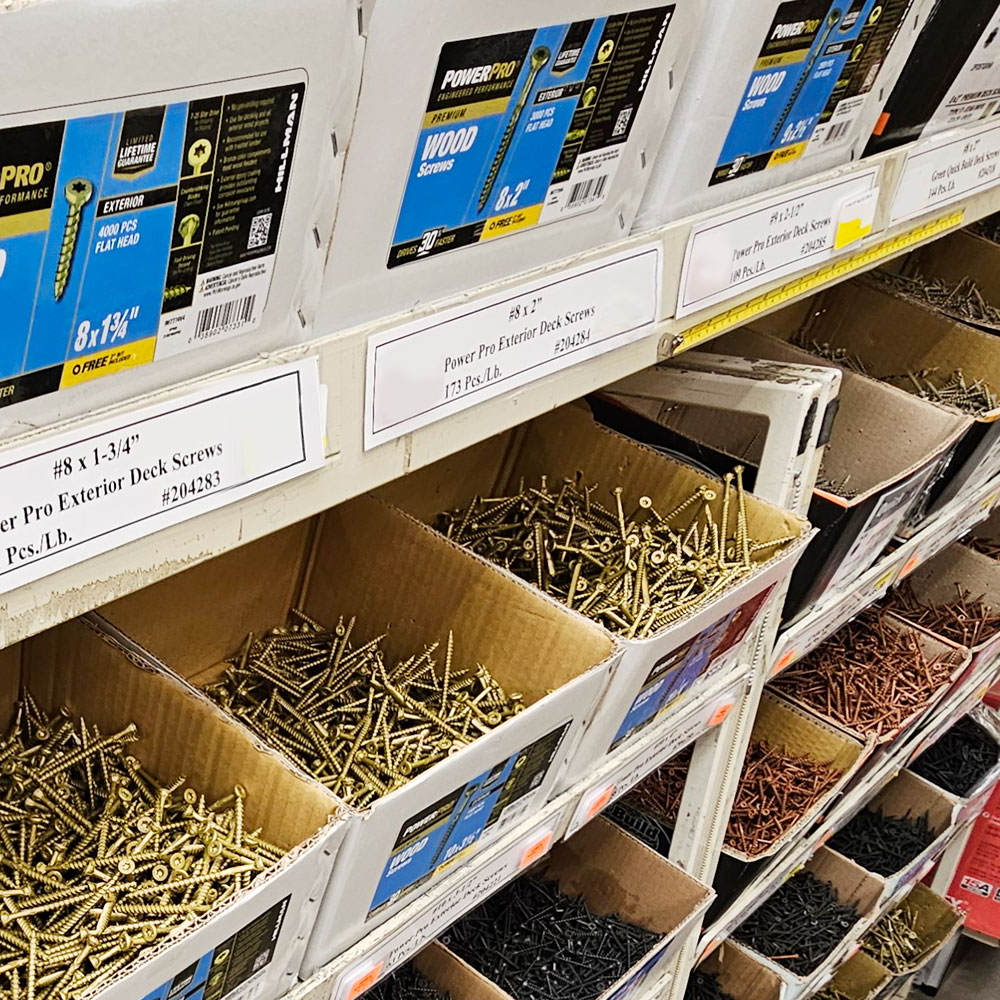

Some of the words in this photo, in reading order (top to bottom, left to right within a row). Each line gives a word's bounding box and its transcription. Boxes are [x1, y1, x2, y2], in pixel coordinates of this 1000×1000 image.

[747, 71, 786, 98] WOOD
[538, 88, 563, 102] EXTERIOR
[431, 108, 467, 124] PREMIUM
[126, 134, 154, 145] LIMITED
[275, 93, 298, 193] HILLMAN
[421, 125, 478, 161] WOOD
[120, 142, 156, 158] LIFETIME
[118, 153, 154, 168] GUARANTEE
[417, 159, 455, 178] Screws
[962, 157, 973, 170] Build
[103, 195, 144, 214] EXTERIOR
[98, 223, 119, 237] 4000
[121, 219, 138, 233] PCS
[95, 239, 116, 254] FLAT
[117, 233, 140, 248] HEAD
[435, 235, 455, 248] FASTER
[733, 246, 751, 262] Power
[753, 241, 764, 253] Pro
[766, 231, 792, 248] Exterior
[793, 225, 808, 238] Deck
[810, 217, 831, 232] Screws
[508, 308, 520, 322] #8
[522, 306, 529, 317] x
[444, 350, 475, 372] Power
[478, 343, 496, 360] Pro
[499, 326, 537, 351] Exterior
[539, 316, 562, 336] Deck
[564, 305, 596, 326] Screws
[554, 329, 590, 354] #204284
[81, 356, 108, 373] FREE
[444, 381, 461, 399] 173
[464, 364, 502, 391] Pcs./Lb.
[53, 457, 73, 479] #8
[78, 457, 88, 472] x
[21, 503, 53, 524] Pro
[58, 478, 124, 512] Exterior
[129, 459, 168, 486] Deck
[172, 442, 223, 471] Screws
[161, 470, 221, 506] #204283
[6, 528, 72, 565] Pcs./Lb.
